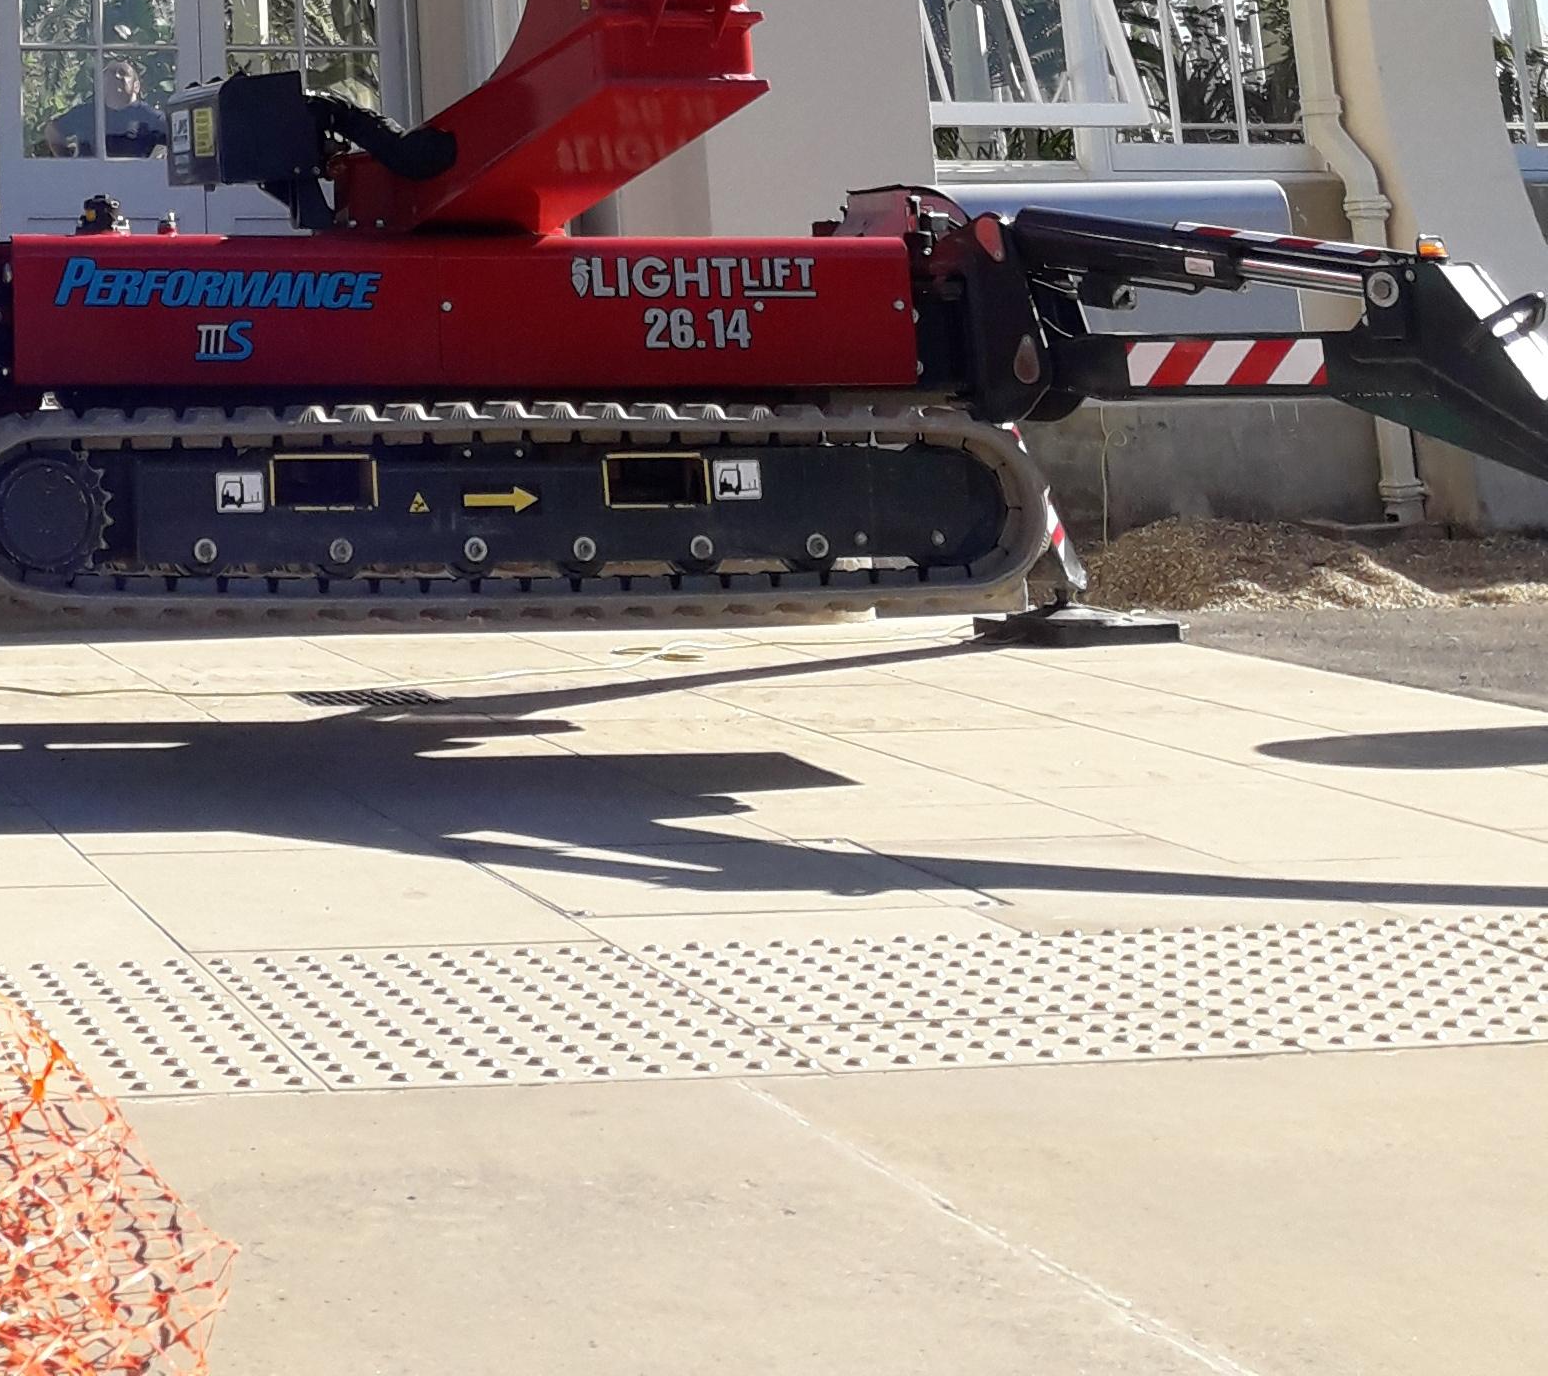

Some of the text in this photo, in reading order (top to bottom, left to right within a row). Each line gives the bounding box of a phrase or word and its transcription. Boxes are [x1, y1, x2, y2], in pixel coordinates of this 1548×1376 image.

[54, 256, 381, 310] PERFORMANCE
[590, 256, 816, 298] LIGHTLIFT
[643, 307, 752, 349] 26.14
